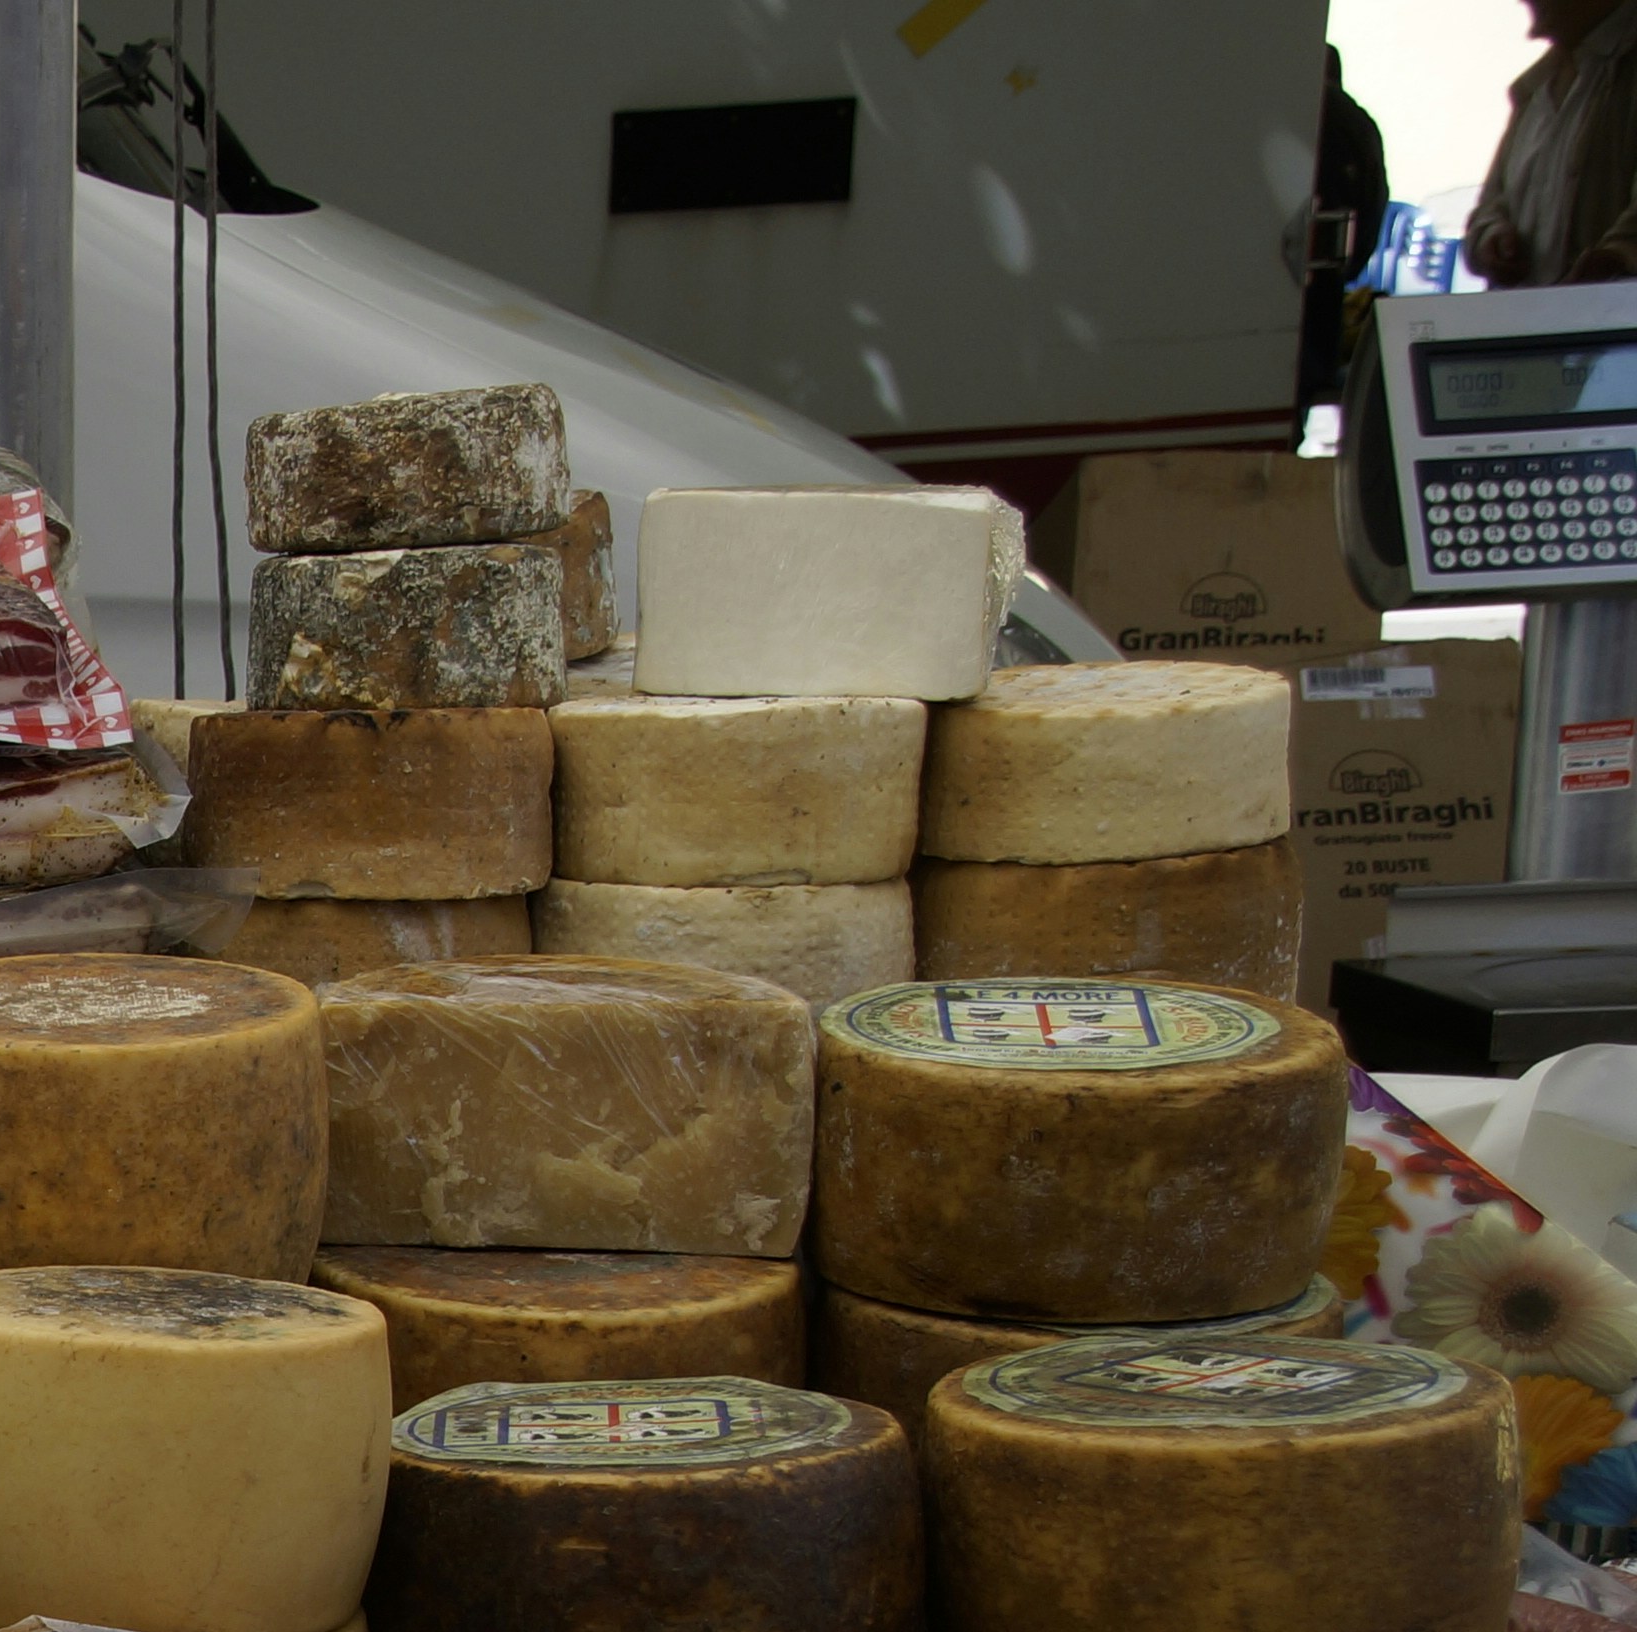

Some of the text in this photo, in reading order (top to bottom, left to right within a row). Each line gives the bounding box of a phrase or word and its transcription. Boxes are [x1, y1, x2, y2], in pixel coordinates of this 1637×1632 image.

[1190, 591, 1257, 622] Biraghi
[1340, 768, 1411, 798] Biraghi
[1296, 797, 1494, 829] ranBiraghi
[1344, 858, 1432, 876] 20 BUSTE
[1338, 884, 1363, 899] da
[1001, 991, 1020, 1000] 4
[1031, 991, 1121, 1001] MORE
